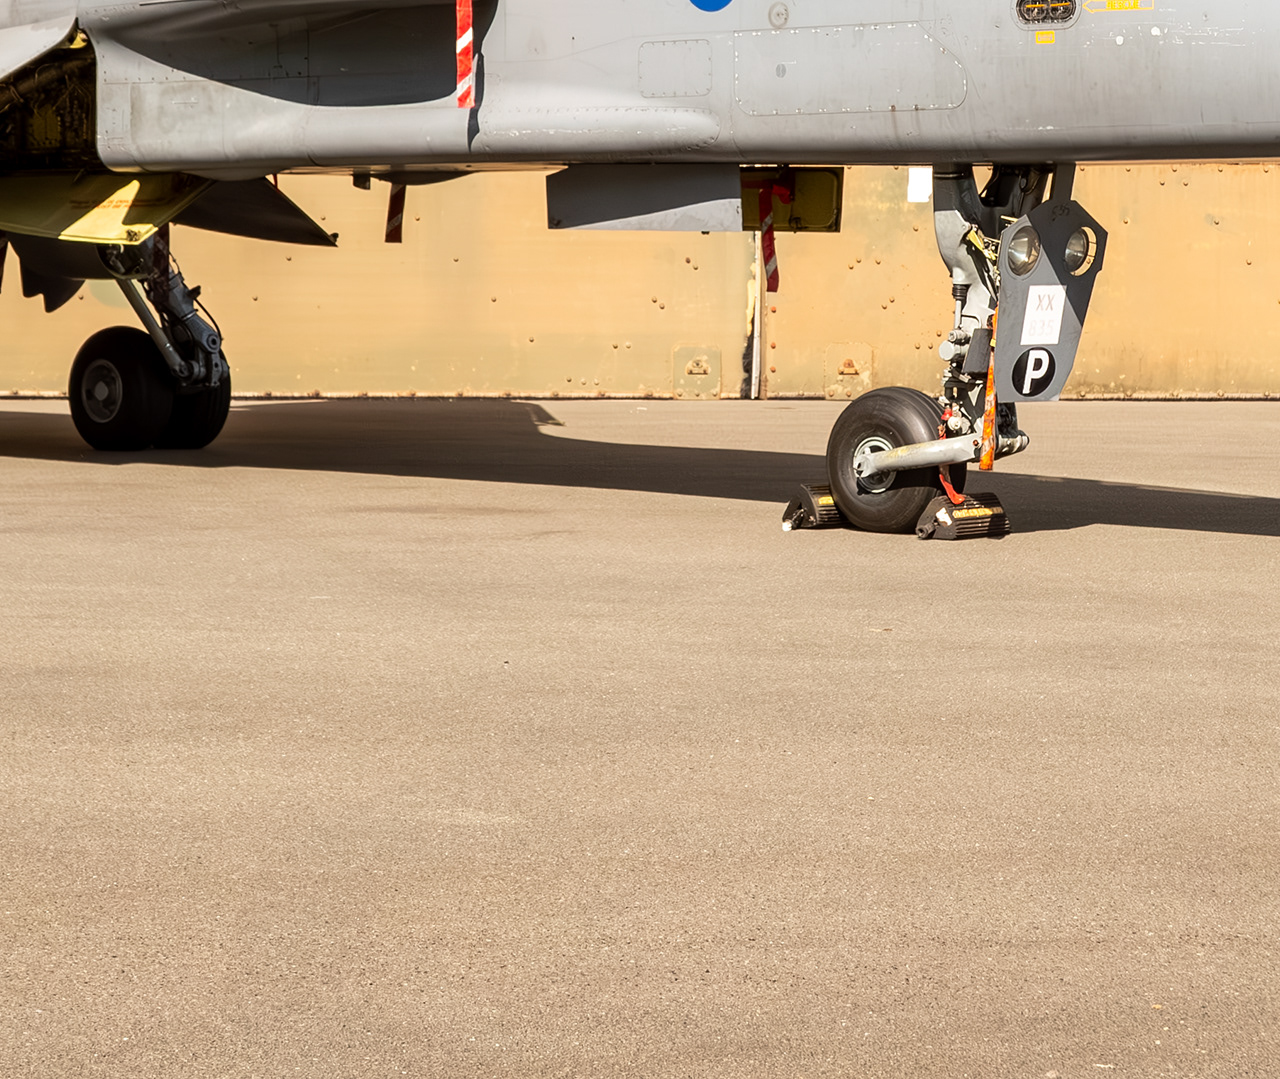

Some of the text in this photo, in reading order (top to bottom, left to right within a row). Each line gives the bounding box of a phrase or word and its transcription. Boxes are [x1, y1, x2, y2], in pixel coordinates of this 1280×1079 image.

[1105, 0, 1141, 10] RESCUE
[1035, 294, 1056, 311] XX
[1022, 349, 1050, 395] P
